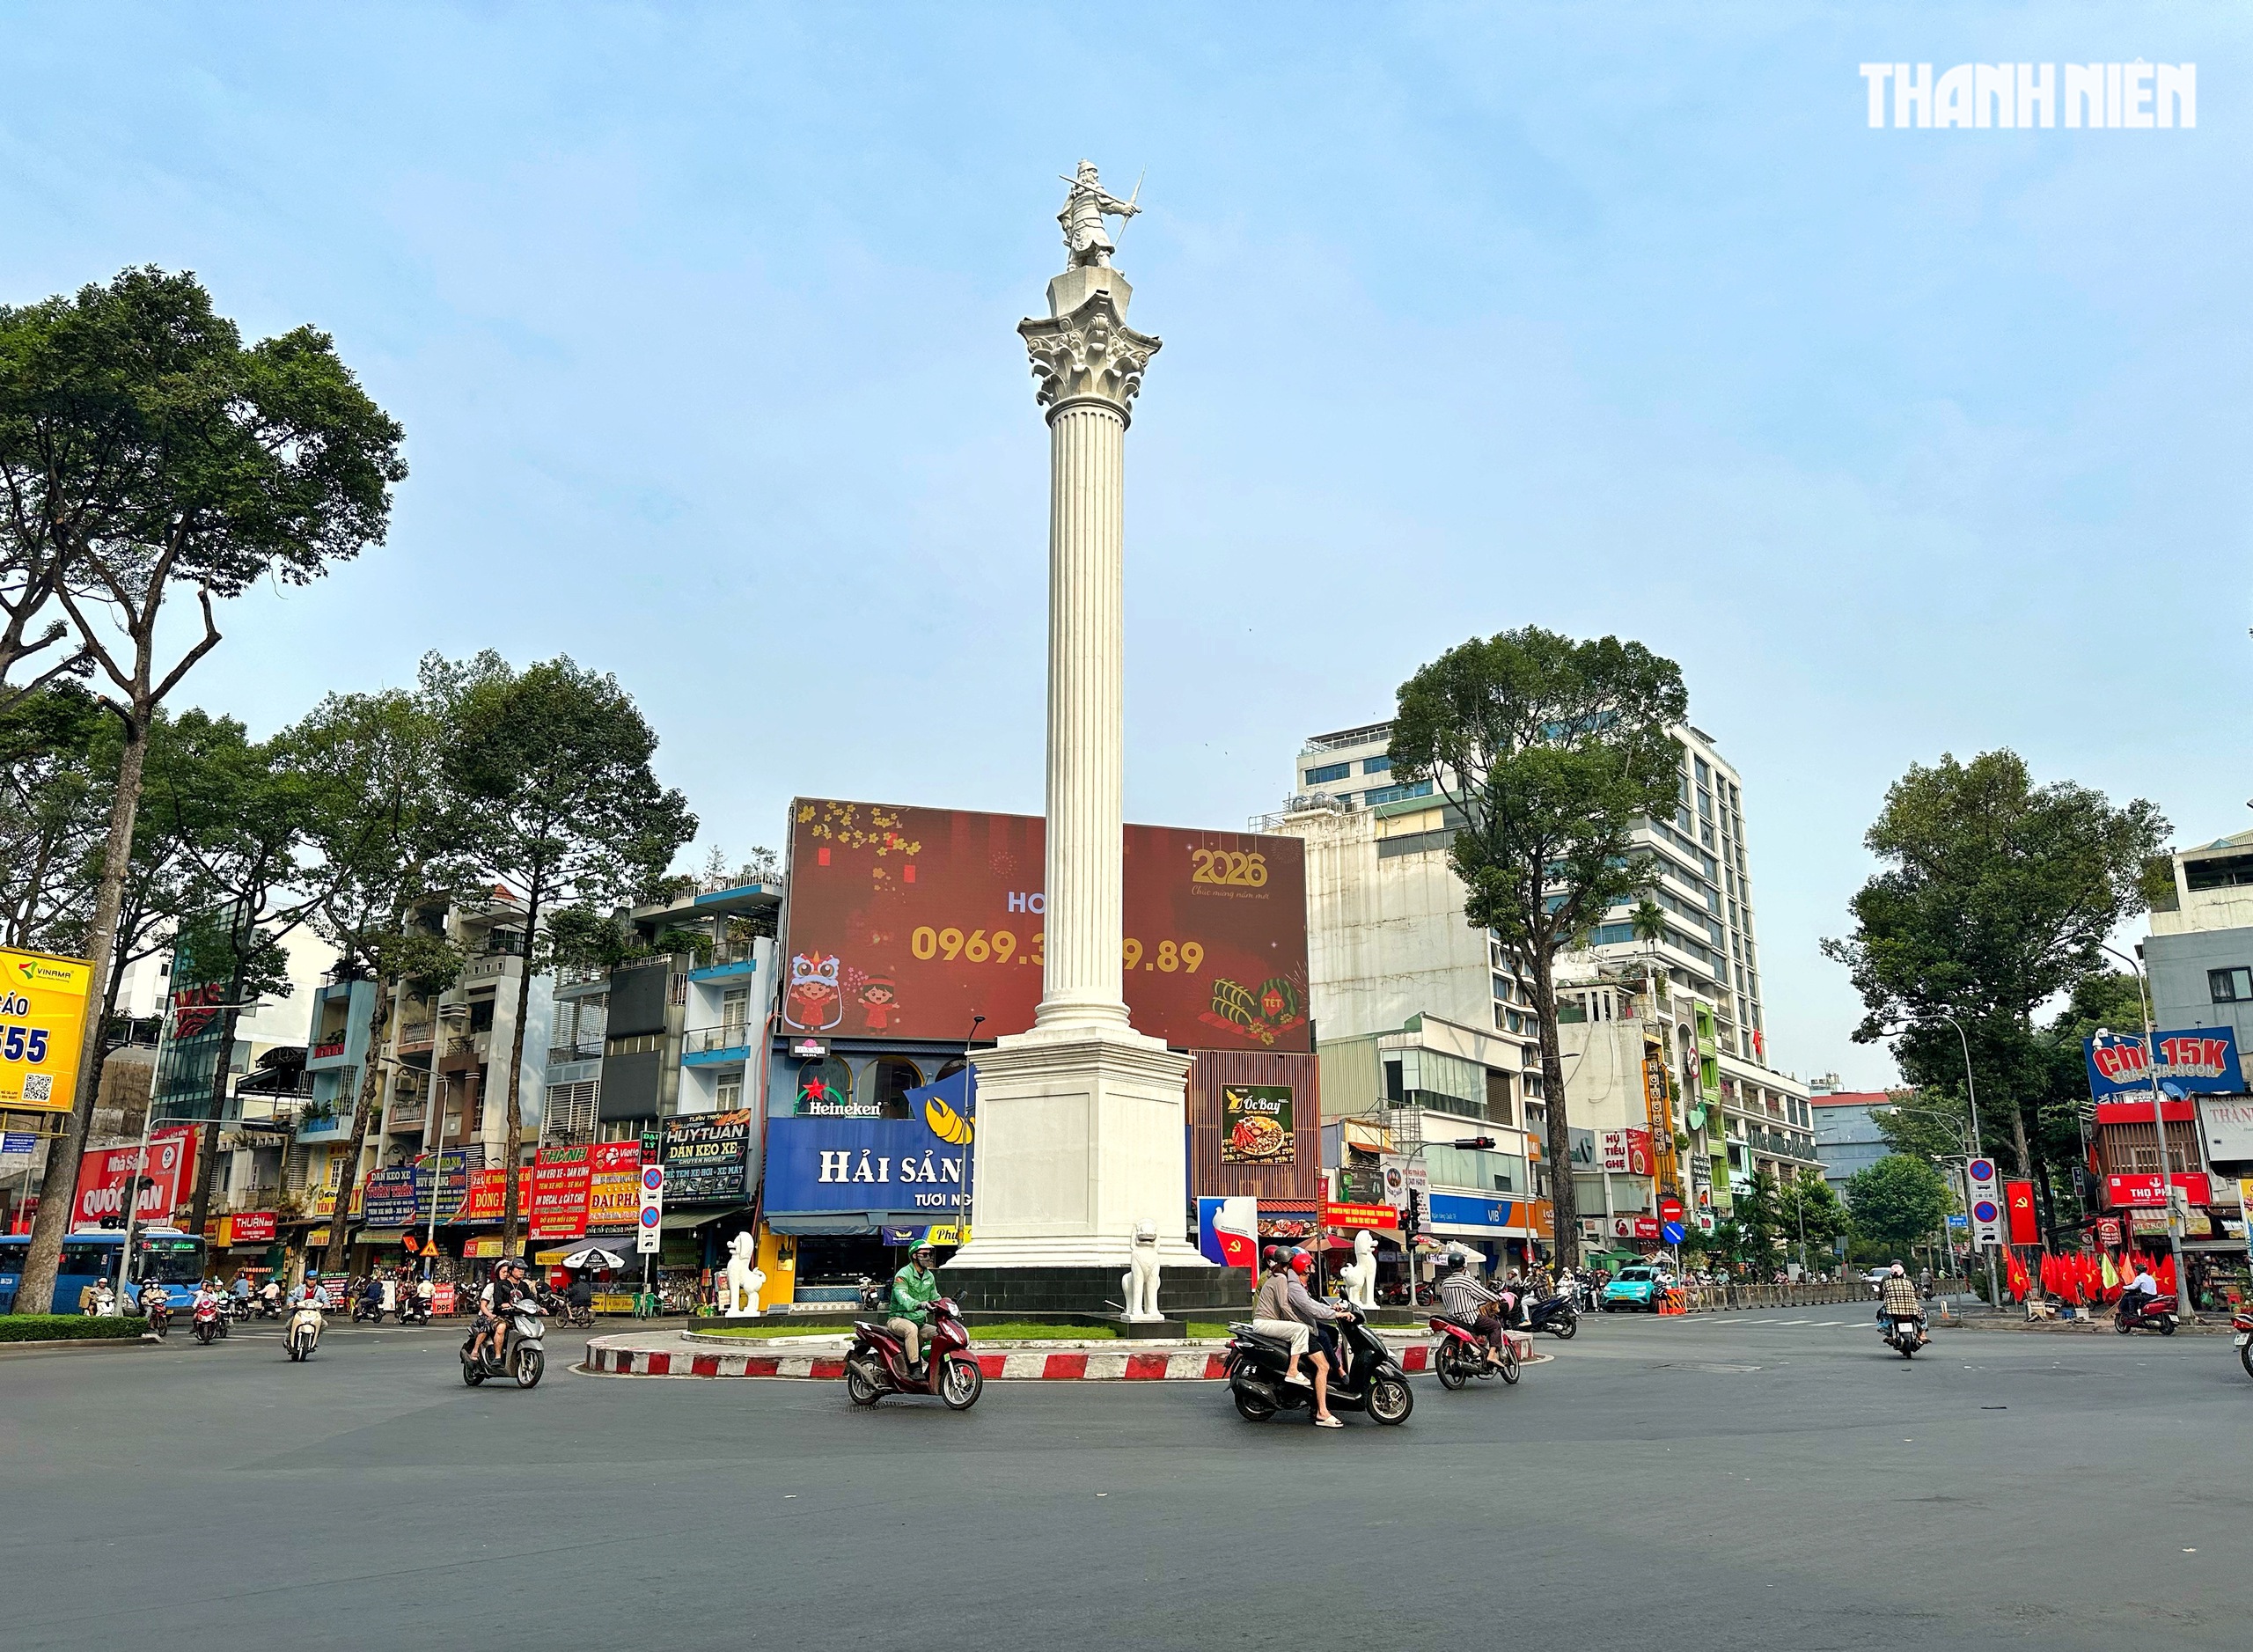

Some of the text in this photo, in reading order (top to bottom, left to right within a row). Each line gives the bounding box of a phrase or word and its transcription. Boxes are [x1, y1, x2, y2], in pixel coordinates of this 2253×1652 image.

[1192, 848, 1268, 888] 2026
[1191, 885, 1212, 896] Chúc
[1237, 889, 1254, 899] năm
[37, 968, 71, 979] VINAMA
[0, 991, 29, 1017] ÁO
[0, 1026, 49, 1063] 55
[2160, 1037, 2229, 1071] 15K
[2175, 1061, 2217, 1076] NGON
[809, 1100, 881, 1116] Heineken
[1243, 1094, 1281, 1115] Ốc Bay
[2209, 1104, 2253, 1123] THÀN
[669, 1141, 738, 1158] DÁN KEO XE
[106, 1153, 150, 1172] Nhà Sáh
[818, 1149, 963, 1183] HẢI SẢN
[1605, 1159, 1626, 1170] GHẸ
[400, 1171, 411, 1180] XE
[556, 1168, 563, 1178] XE
[914, 1193, 972, 1207] TƯƠI NG
[2130, 1188, 2151, 1199] THỌ
[236, 1214, 265, 1230] THUẬN
[1487, 1209, 1500, 1222] VIB
[936, 1228, 959, 1244] Phụ
